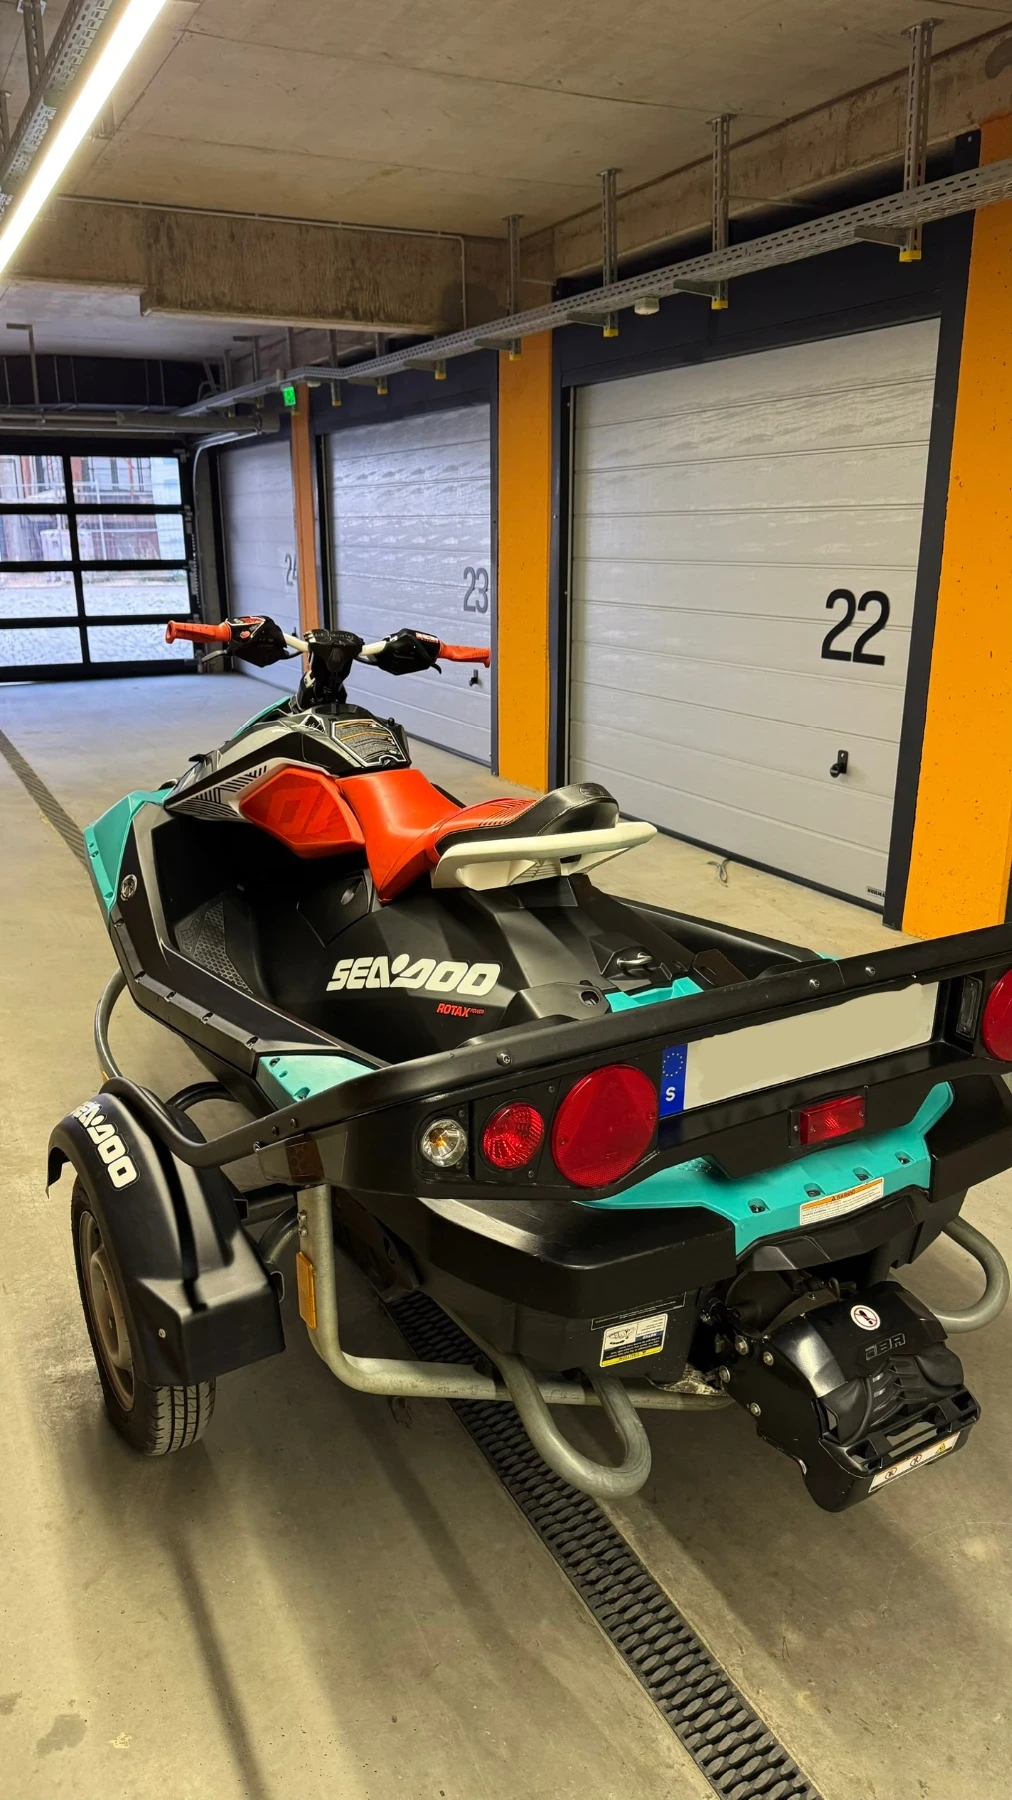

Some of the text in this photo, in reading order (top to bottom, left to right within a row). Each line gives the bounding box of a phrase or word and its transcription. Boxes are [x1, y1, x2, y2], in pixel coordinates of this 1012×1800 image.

[463, 566, 489, 614] 23
[821, 588, 890, 666] 22
[436, 1003, 471, 1018] ROTAX
[665, 1086, 676, 1102] S
